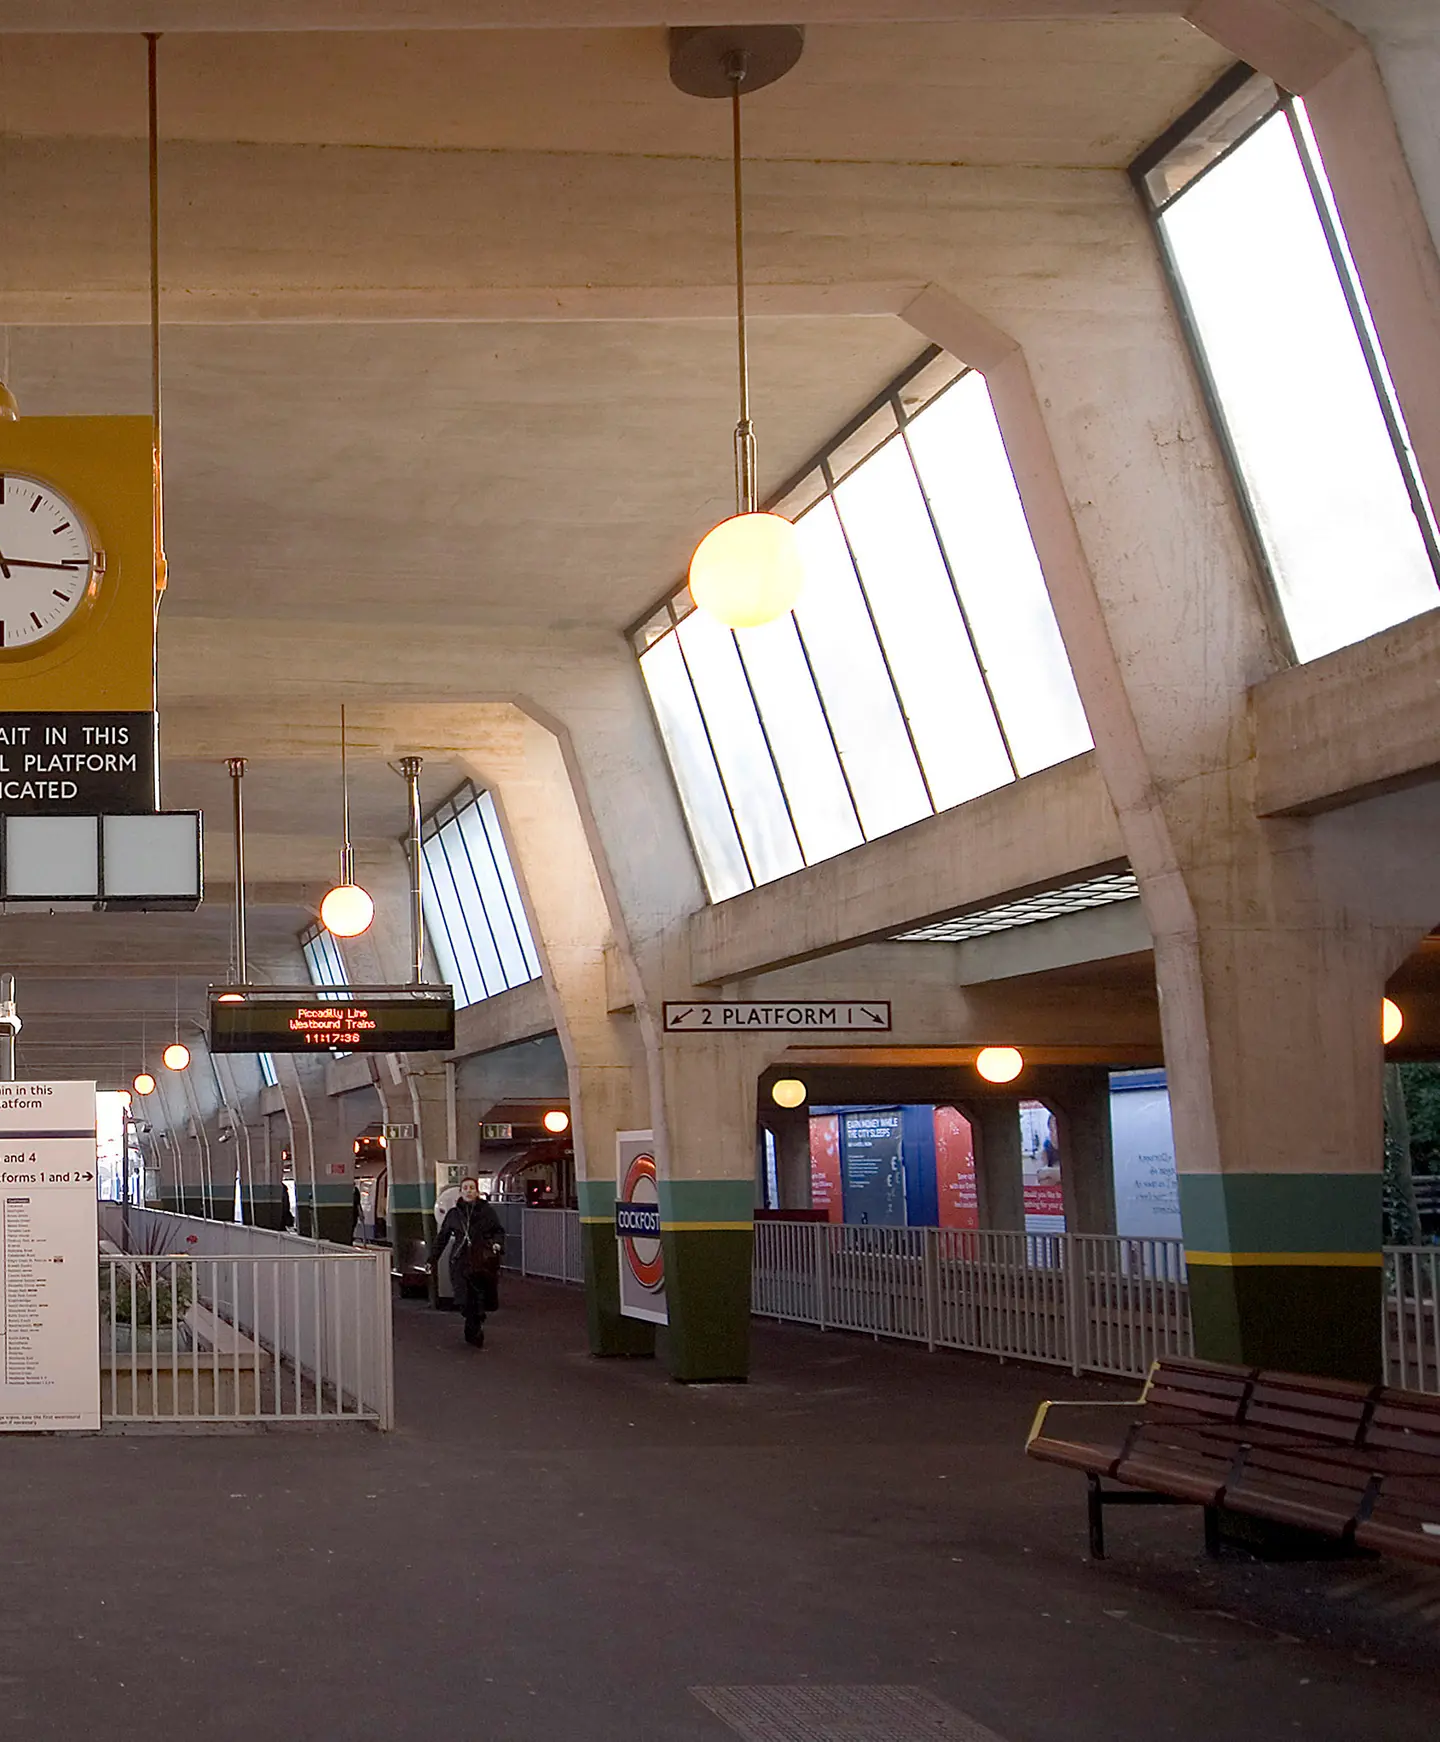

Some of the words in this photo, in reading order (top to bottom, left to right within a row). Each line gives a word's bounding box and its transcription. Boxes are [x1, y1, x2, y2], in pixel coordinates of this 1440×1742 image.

[45, 727, 67, 745] IN
[82, 727, 129, 745] THIS
[24, 753, 137, 772] PLATFORM
[298, 1008, 344, 1020] Piccadilly
[347, 1008, 368, 1018] Line
[702, 1008, 712, 1025] 2
[723, 1008, 836, 1025] PLATFORM
[848, 1008, 852, 1024] 1
[289, 1019, 341, 1030] Westbound
[345, 1019, 376, 1030] Trains
[16, 1086, 27, 1095] in
[30, 1085, 53, 1095] this
[3, 1153, 25, 1163] and
[28, 1152, 37, 1162] 4
[40, 1172, 45, 1182] 1
[49, 1172, 70, 1182] and
[74, 1172, 81, 1182] 2
[618, 1210, 660, 1231] COCKFOST
